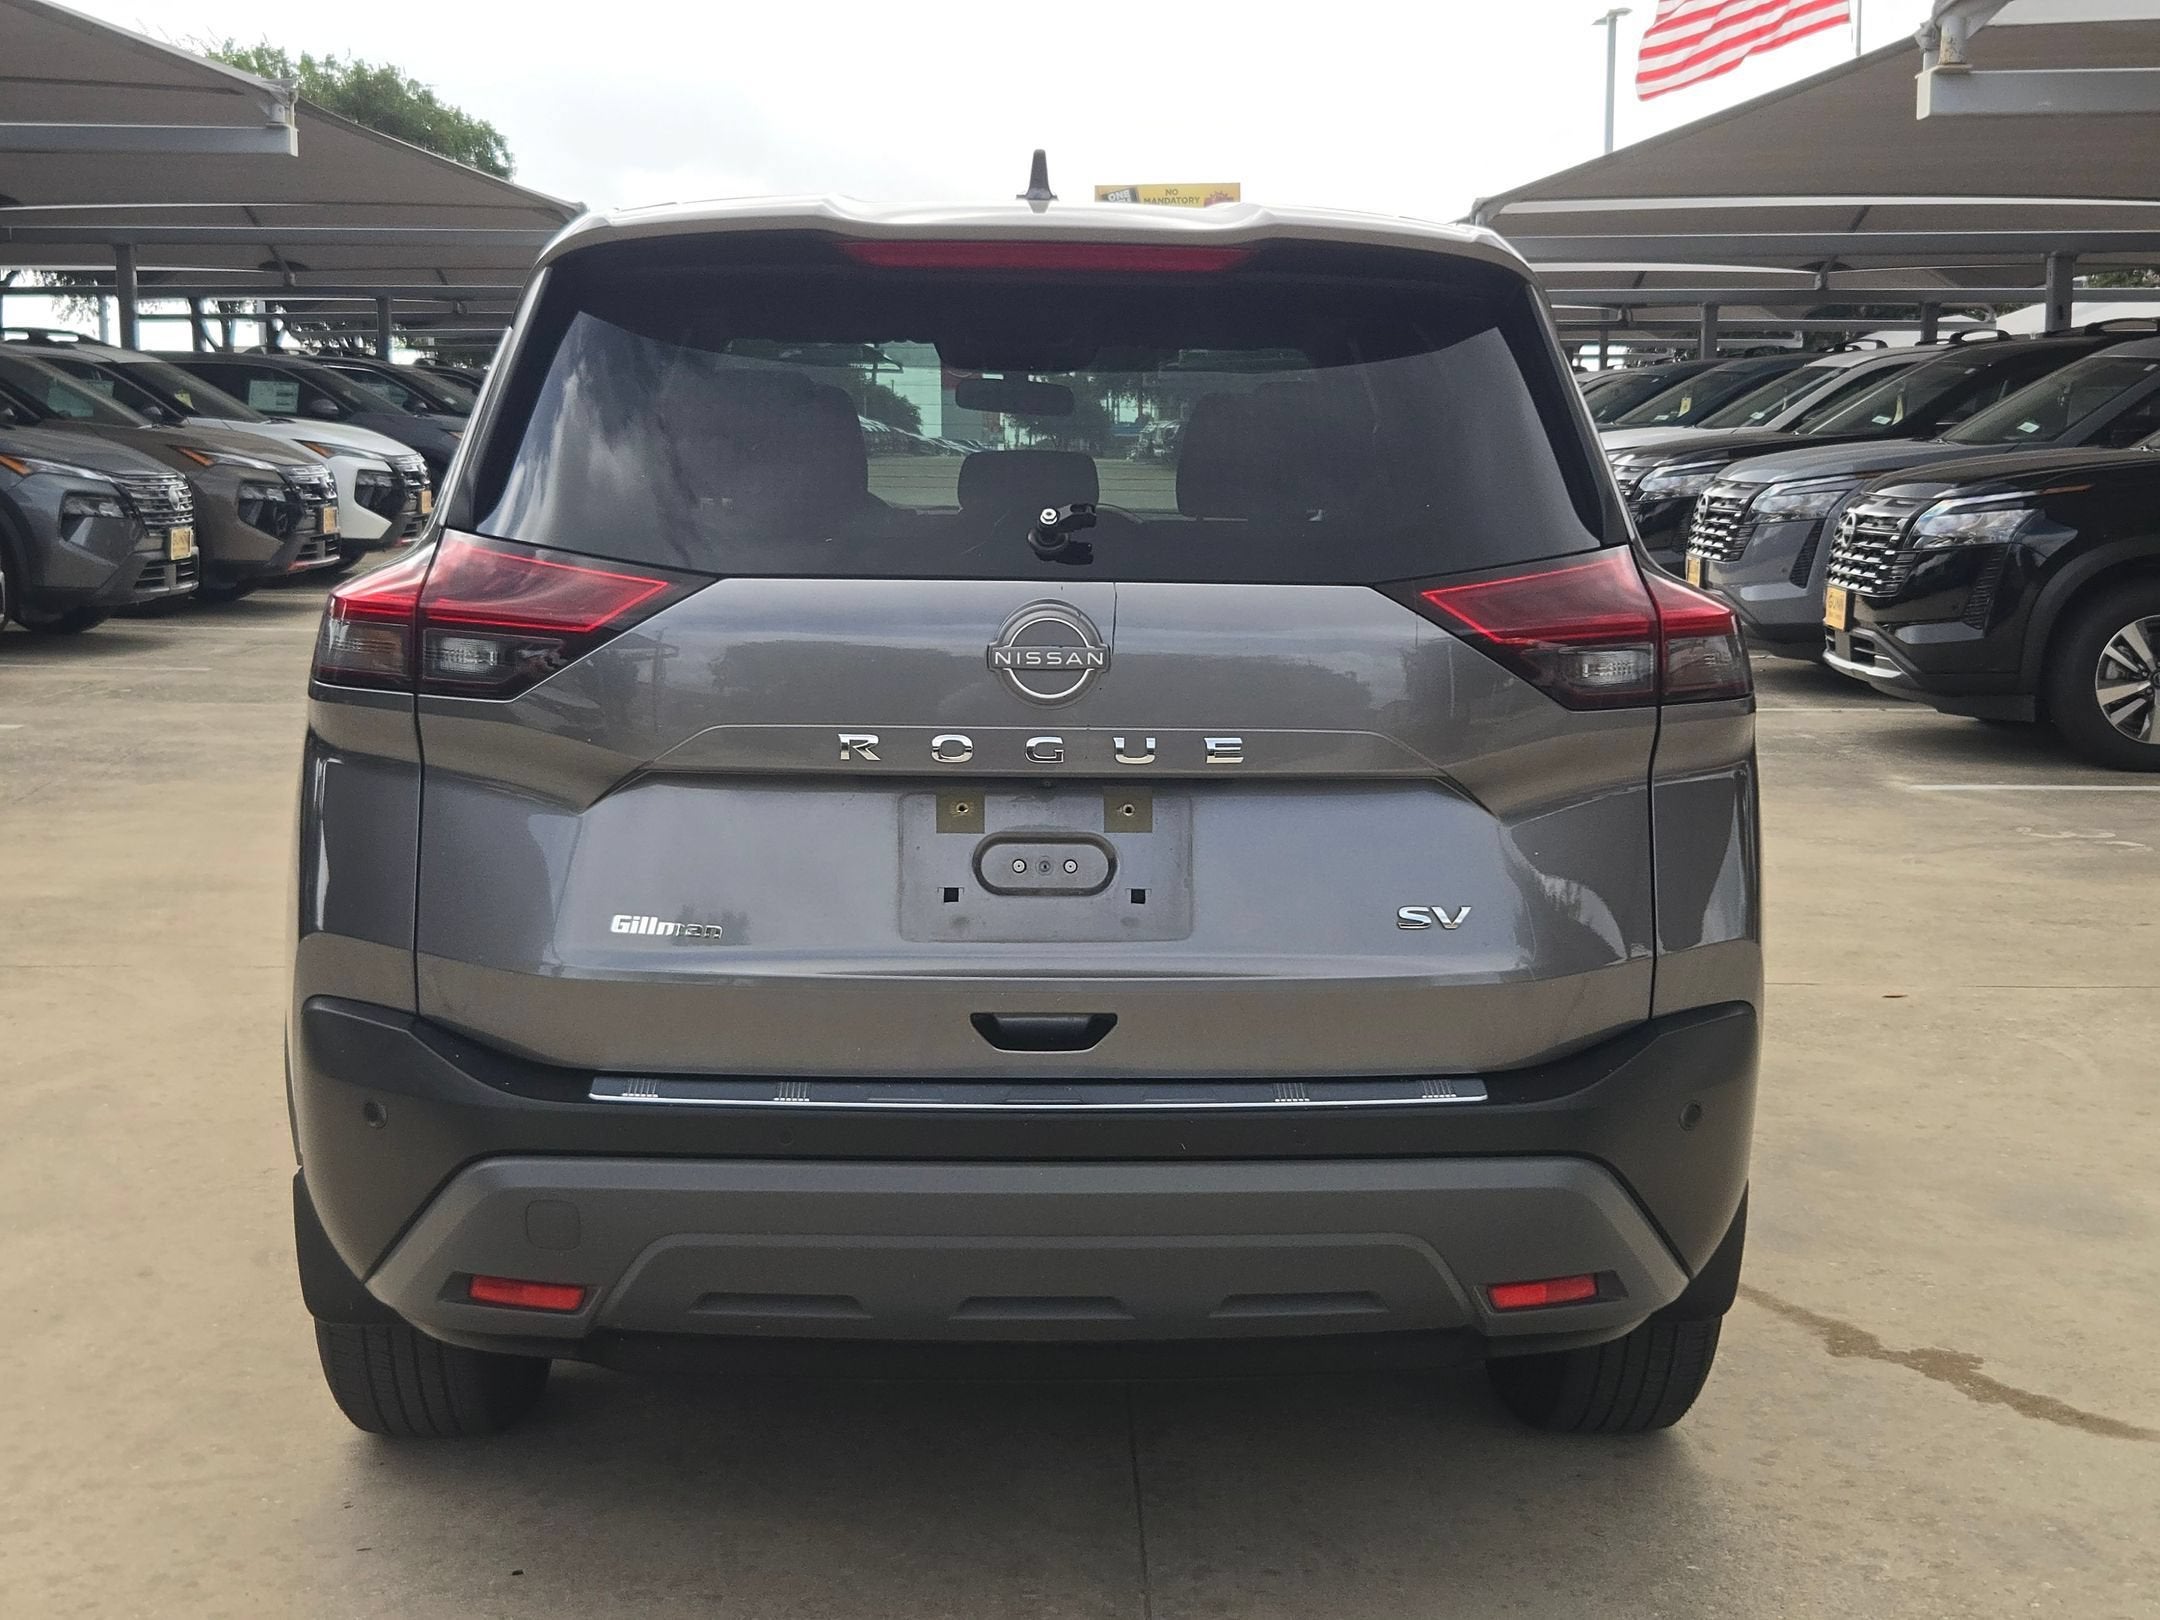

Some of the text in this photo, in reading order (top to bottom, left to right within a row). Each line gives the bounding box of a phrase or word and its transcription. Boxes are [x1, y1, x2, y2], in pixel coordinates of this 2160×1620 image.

[1143, 196, 1200, 205] MANDATORY
[1164, 188, 1179, 197] NO
[994, 651, 1103, 665] NISSAN
[838, 733, 1244, 764] ROGUE
[610, 914, 723, 939] Gillman
[1397, 905, 1472, 930] SV
